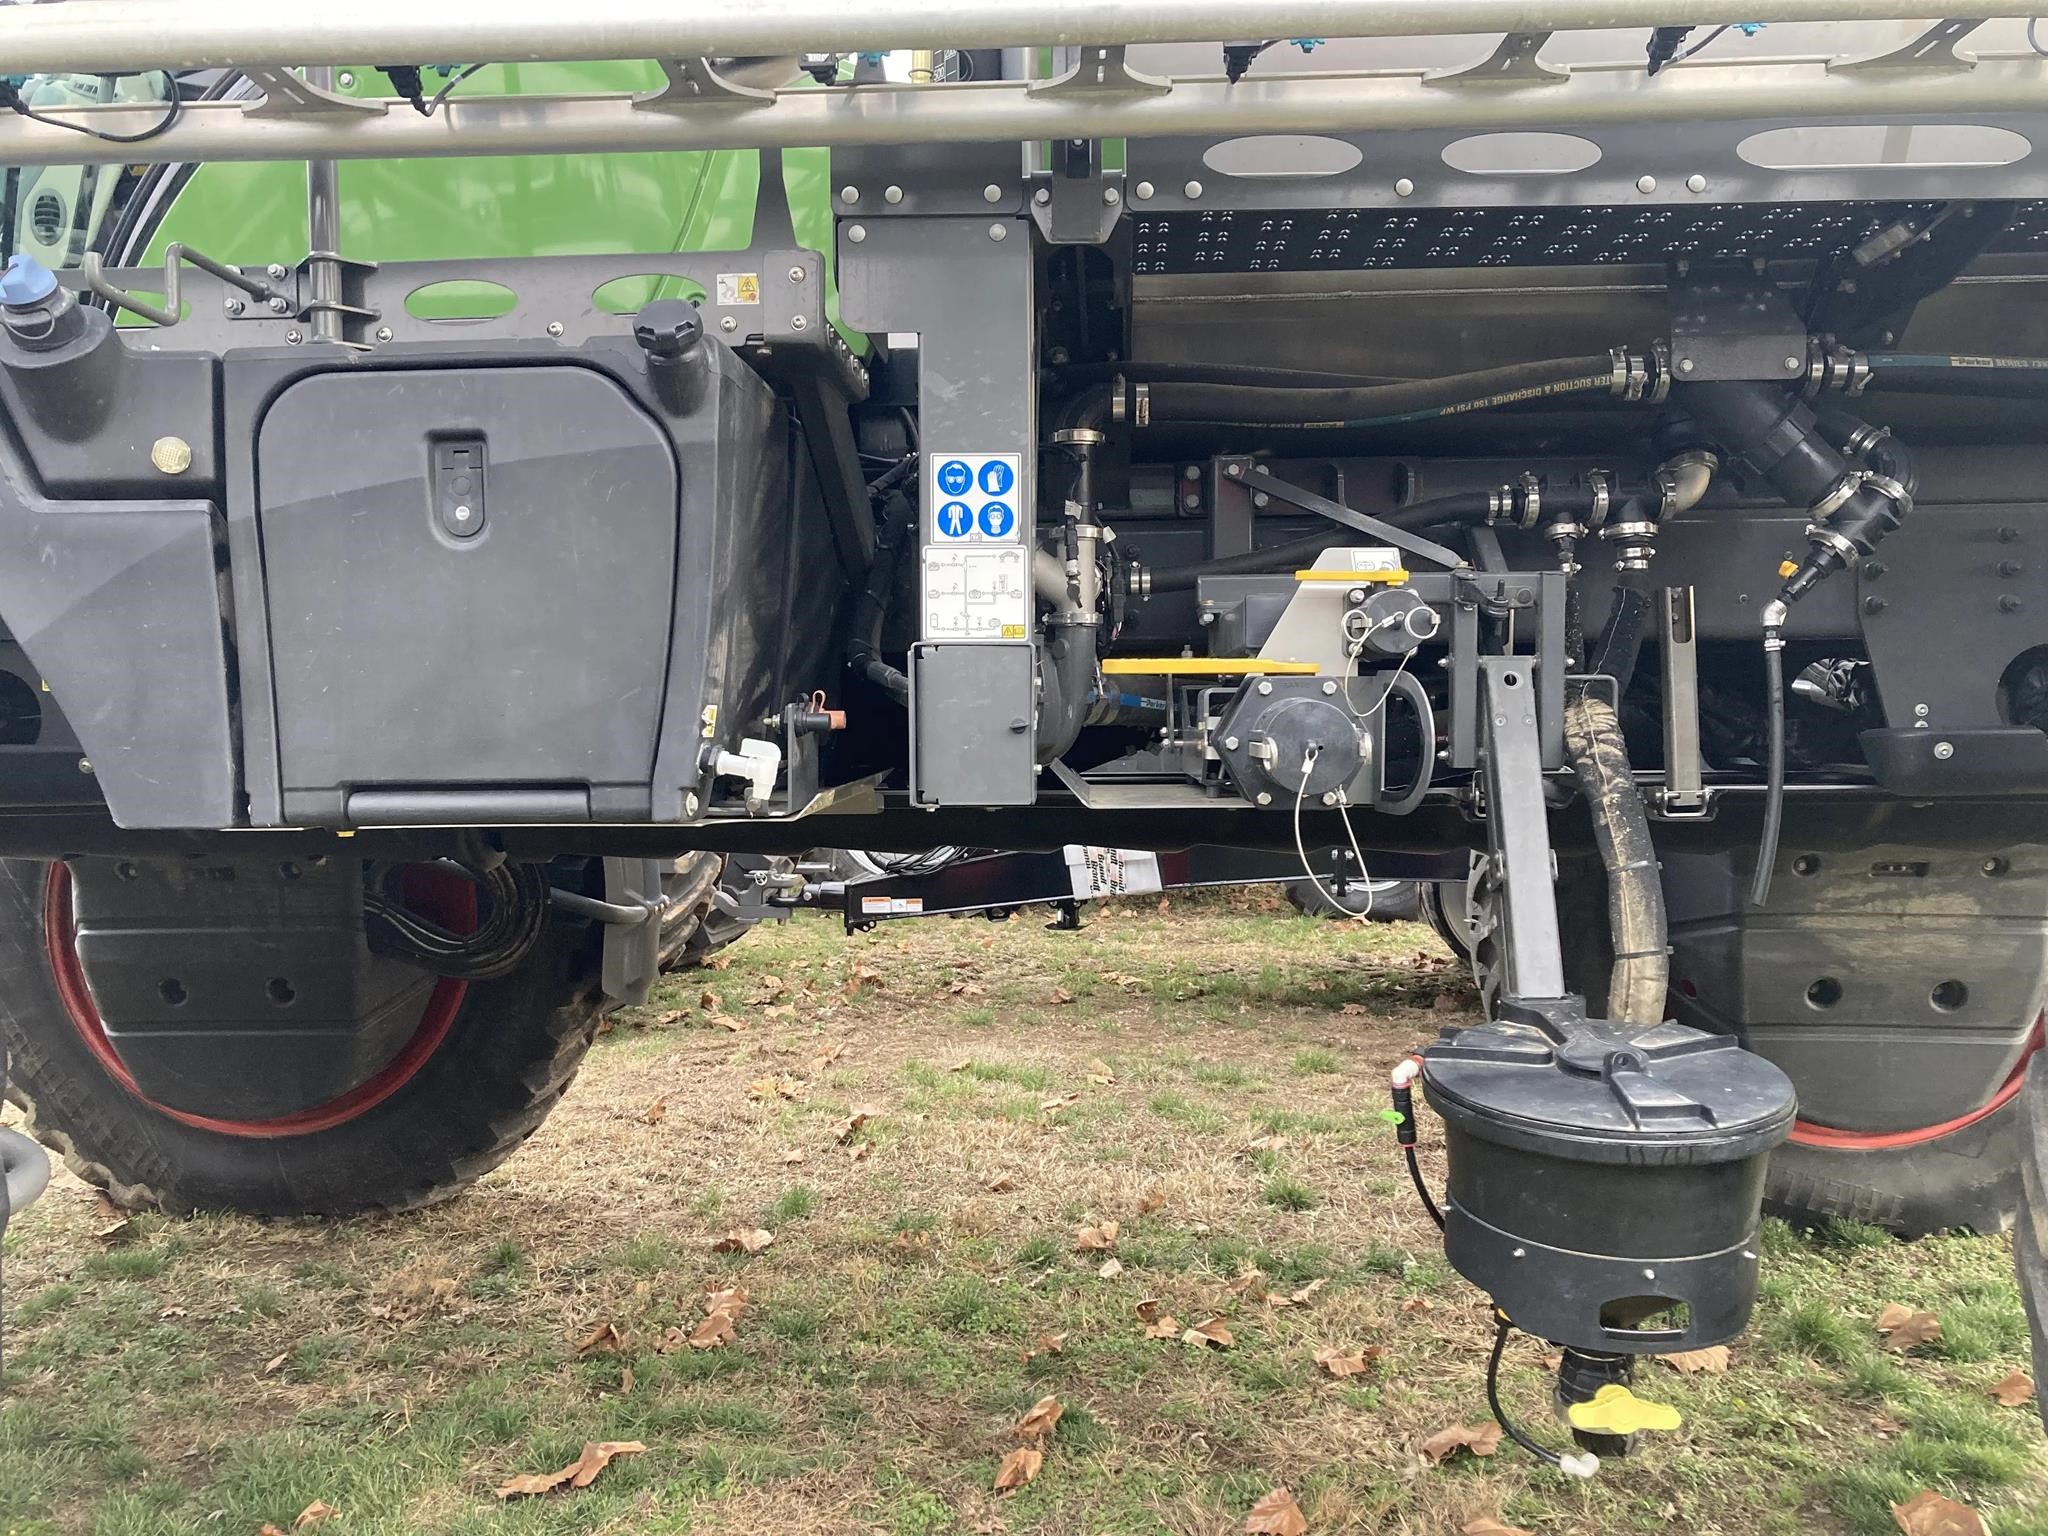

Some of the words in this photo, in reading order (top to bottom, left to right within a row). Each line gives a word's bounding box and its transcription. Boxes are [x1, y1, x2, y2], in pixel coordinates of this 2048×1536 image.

[1955, 357, 1992, 366] Parker
[1544, 385, 1551, 394] &
[1553, 378, 1592, 392] SUCTION
[1492, 388, 1541, 405] DISCHARGE
[1457, 402, 1472, 412] PSI
[1473, 399, 1489, 409] 150
[1098, 854, 1107, 884] Brandt
[1091, 860, 1100, 891] Brandt
